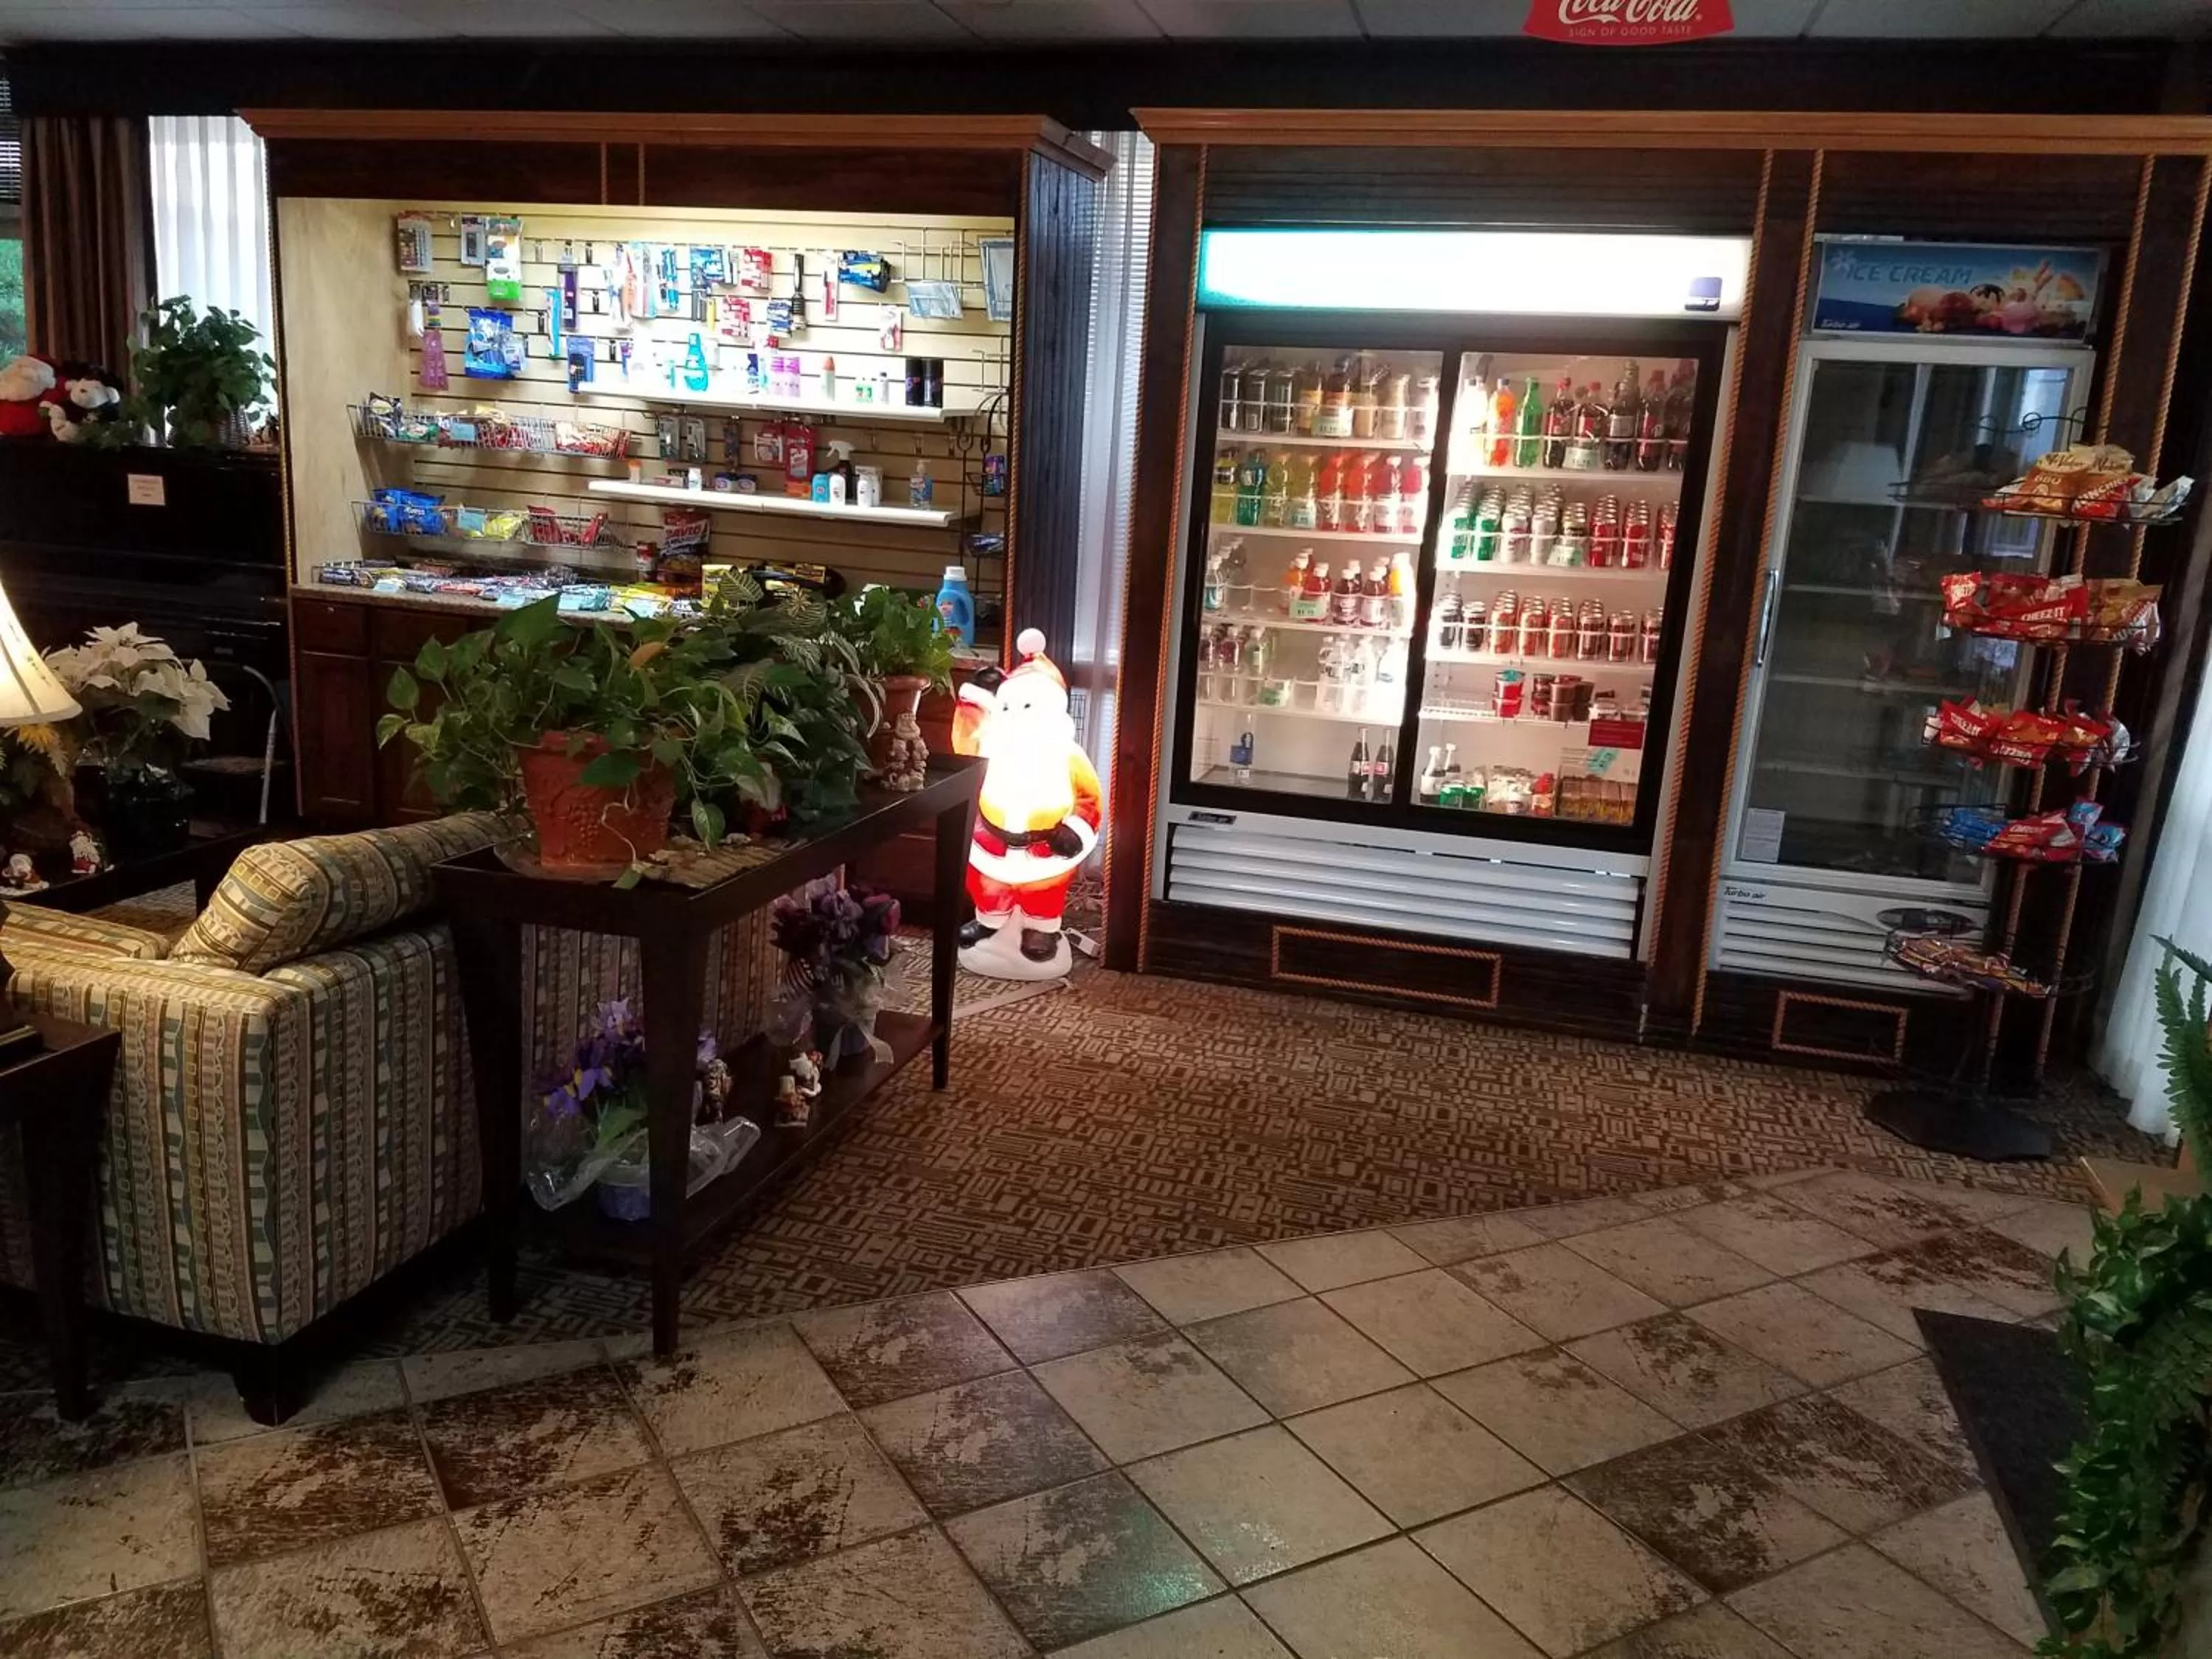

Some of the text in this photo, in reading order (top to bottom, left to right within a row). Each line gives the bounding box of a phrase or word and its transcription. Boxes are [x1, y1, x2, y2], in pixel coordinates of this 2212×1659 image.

[1568, 25, 1693, 37] SIGN OF GOOD TASTE
[1846, 264, 1974, 284] ICE CREAM
